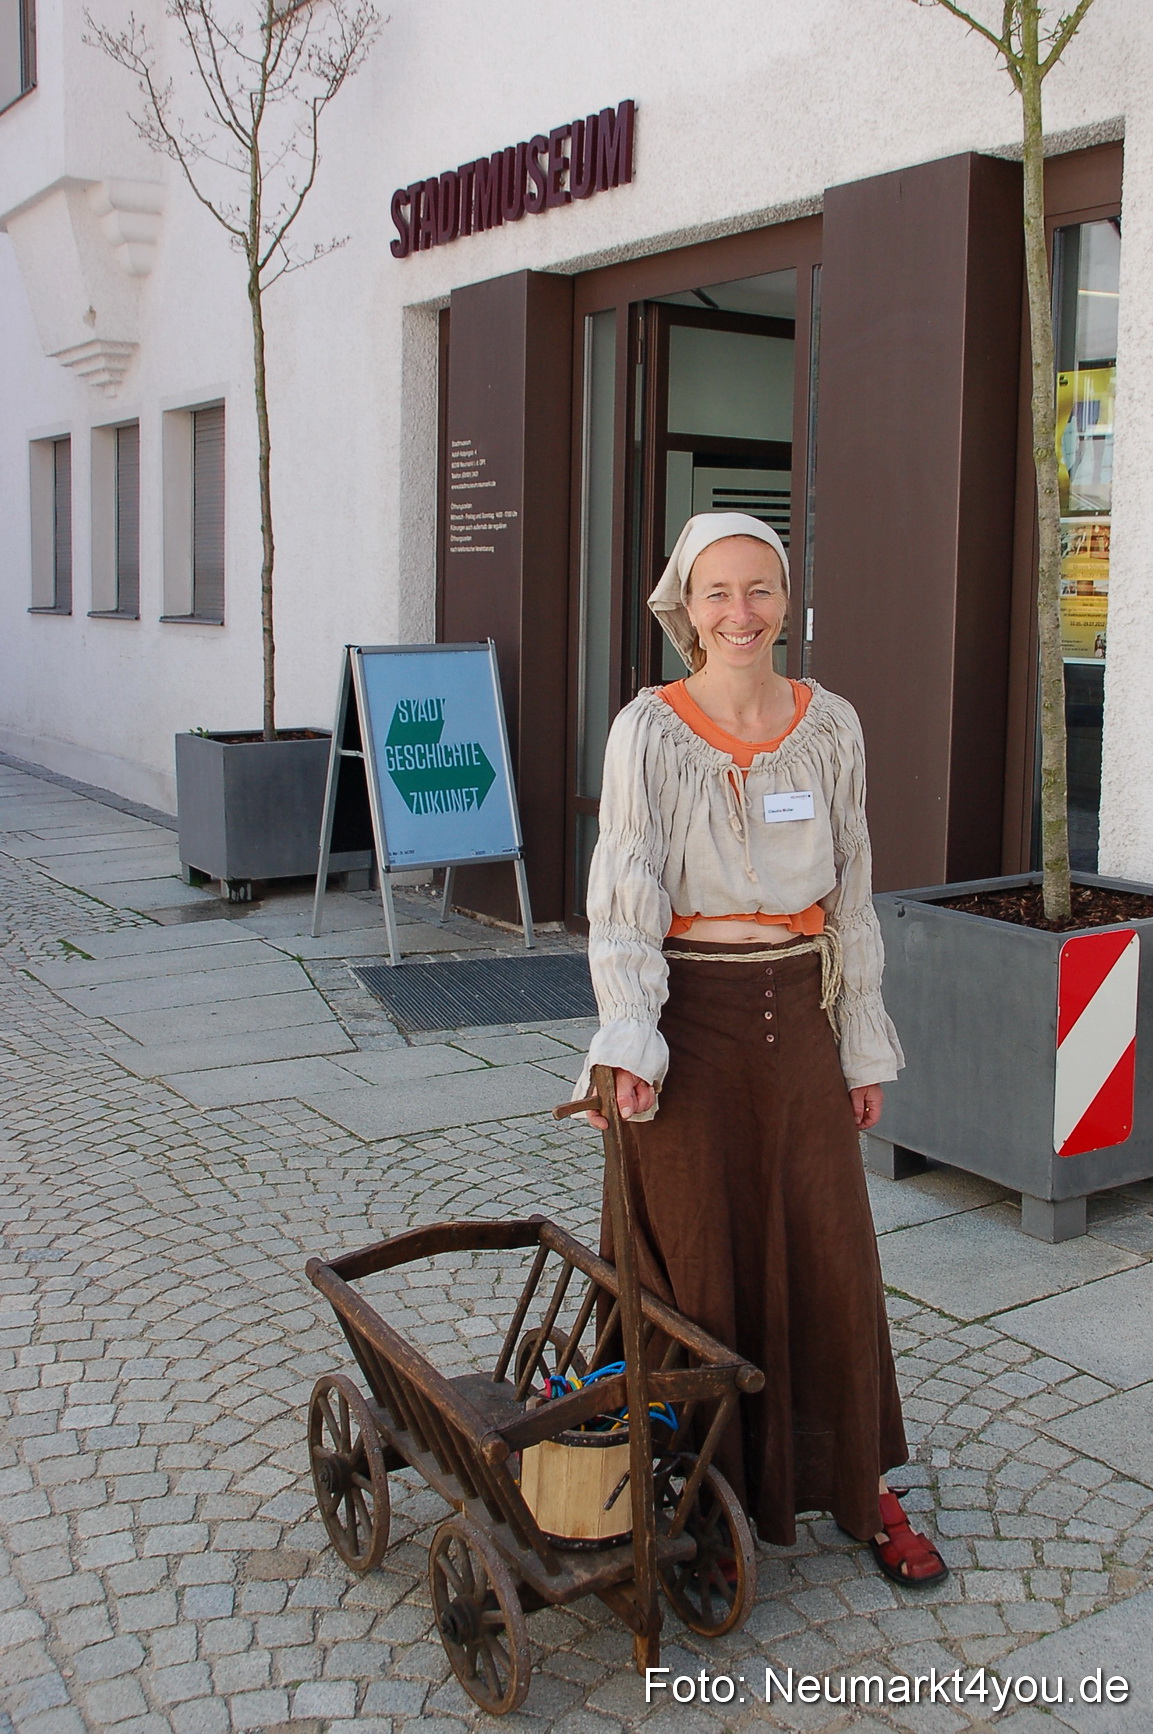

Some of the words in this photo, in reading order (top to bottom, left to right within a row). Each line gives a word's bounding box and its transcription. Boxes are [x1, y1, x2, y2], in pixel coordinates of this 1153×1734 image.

[390, 99, 634, 258] STADTMUSEUM
[399, 698, 446, 723] STADT
[385, 742, 481, 772] GESCHICHTE
[410, 787, 479, 815] ZUKUNFT
